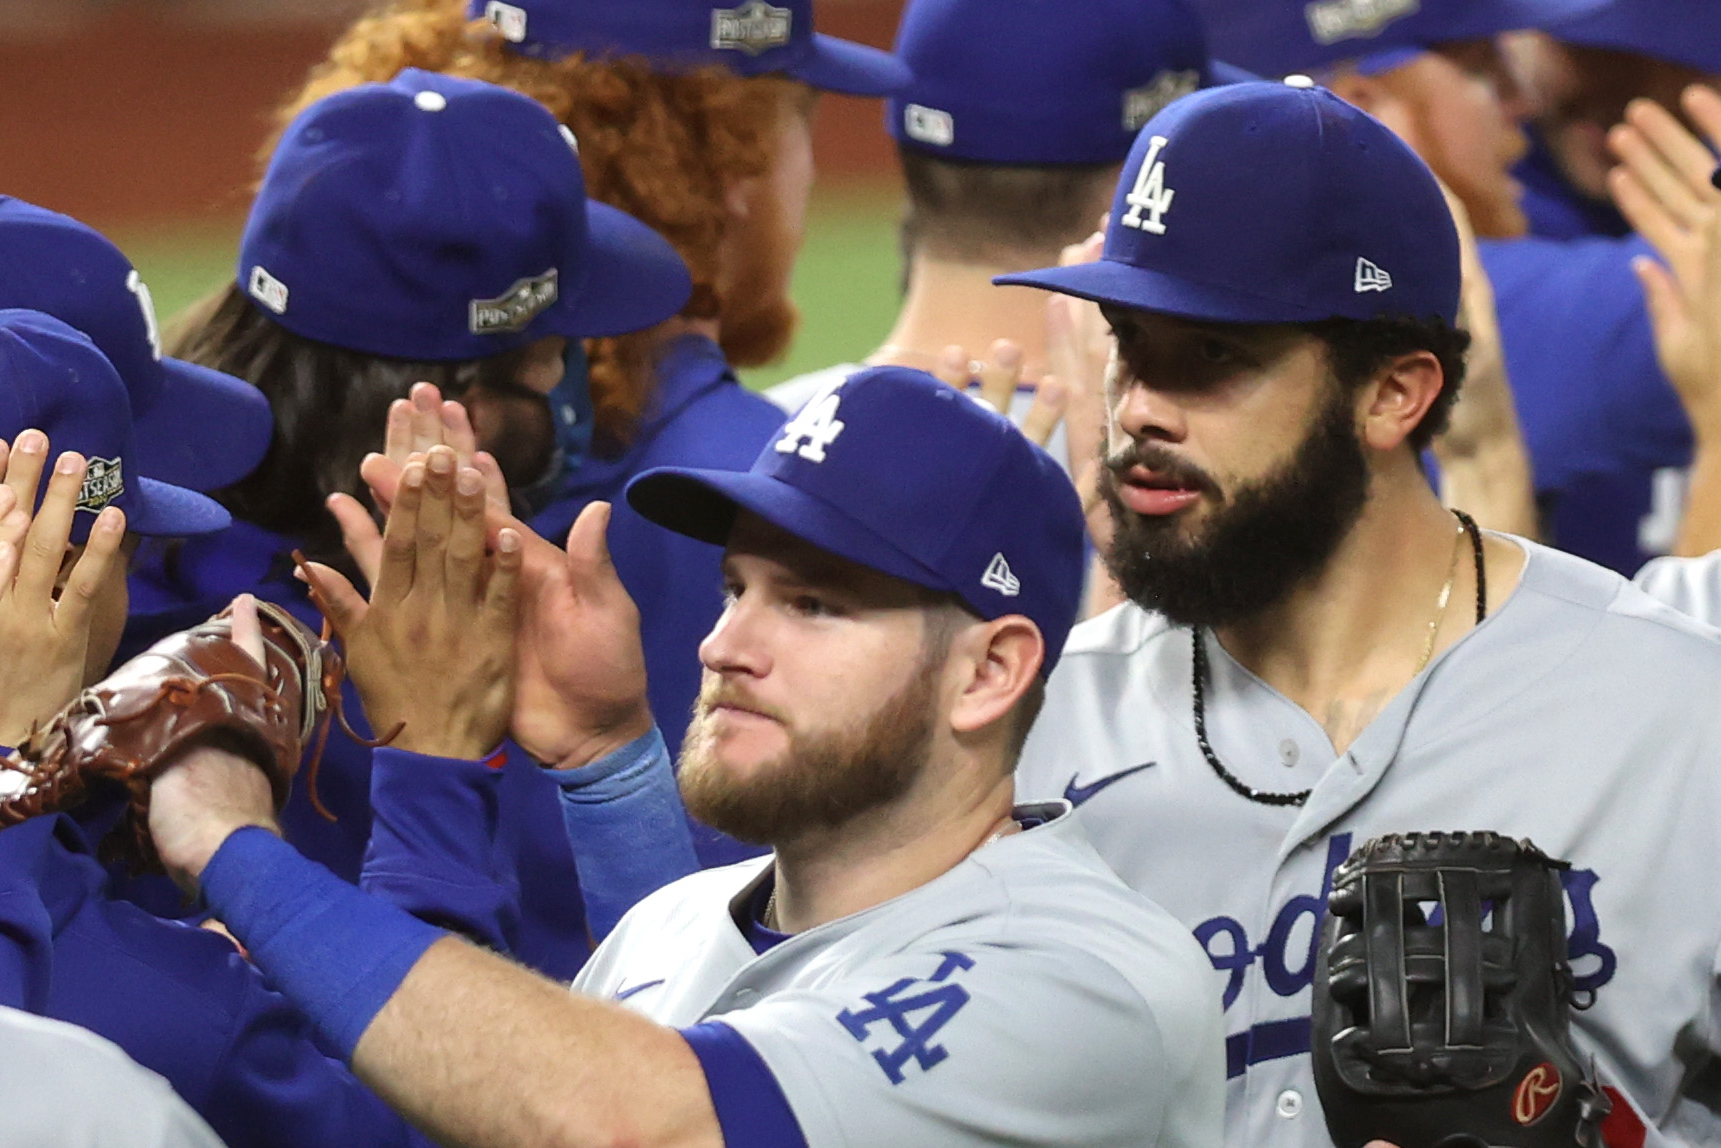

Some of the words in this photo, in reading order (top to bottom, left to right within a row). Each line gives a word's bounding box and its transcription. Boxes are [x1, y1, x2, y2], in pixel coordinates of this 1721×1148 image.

[1121, 135, 1175, 235] LA
[775, 375, 846, 463] LA
[836, 950, 977, 1086] LA
